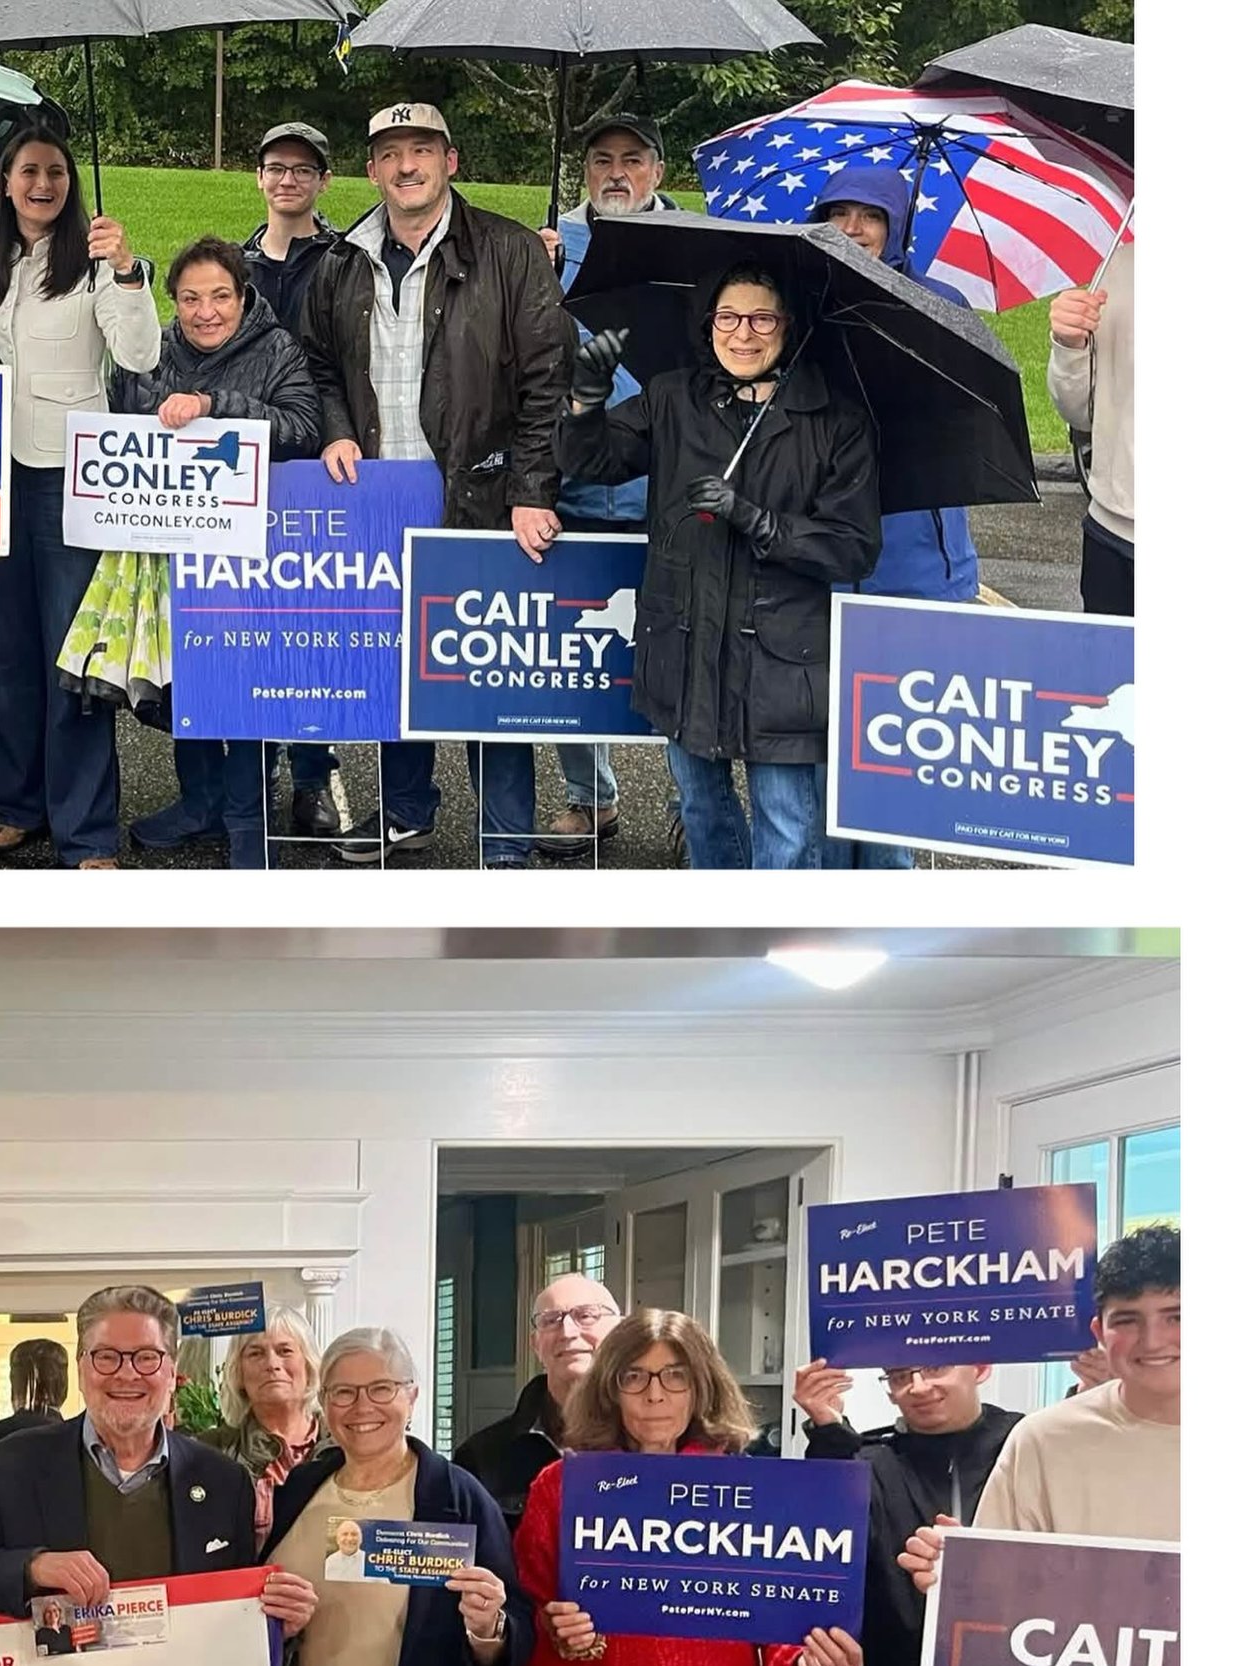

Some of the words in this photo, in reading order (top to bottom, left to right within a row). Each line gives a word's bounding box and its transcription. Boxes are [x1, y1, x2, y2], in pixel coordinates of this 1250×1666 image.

[391, 107, 411, 123] NY
[99, 430, 174, 459] CAIT
[81, 460, 220, 491] CONLEY
[109, 491, 219, 508] CONGRESS
[94, 511, 231, 530] CAITCONLEY.COM
[266, 510, 347, 536] PETE
[175, 551, 403, 590] HARCKHA
[455, 590, 554, 627] CAIT
[184, 631, 213, 649] for
[224, 632, 271, 647] NEW
[281, 632, 340, 648] YORK
[349, 632, 403, 648] SENA
[431, 629, 613, 668] CONLEY
[469, 670, 611, 689] CONGRESS
[252, 687, 366, 699] PeteForNY.com
[899, 670, 1032, 722] CAIT
[867, 714, 1115, 778] CONLEY
[917, 765, 1111, 805] CONGRESS
[907, 1219, 987, 1245] PETE
[819, 1247, 1085, 1294] HARCKHAM
[183, 1314, 212, 1325] CHRIS
[215, 1309, 257, 1321] BURDICK
[827, 1316, 855, 1331] for
[865, 1312, 912, 1328] NEW
[922, 1310, 981, 1325] YORK
[990, 1304, 1076, 1321] SENATE
[670, 1483, 754, 1509] PETE
[574, 1517, 853, 1563] HARCKHAM
[368, 1553, 405, 1565] CHRIS
[409, 1556, 465, 1568] BURDICK
[580, 1575, 610, 1590] for
[620, 1578, 670, 1592] NEW
[680, 1580, 741, 1596] YORK
[750, 1584, 840, 1603] SENATE
[74, 1605, 115, 1619] ERIKA
[116, 1600, 164, 1615] PIERCE
[661, 1605, 750, 1618] PeteForNY.com
